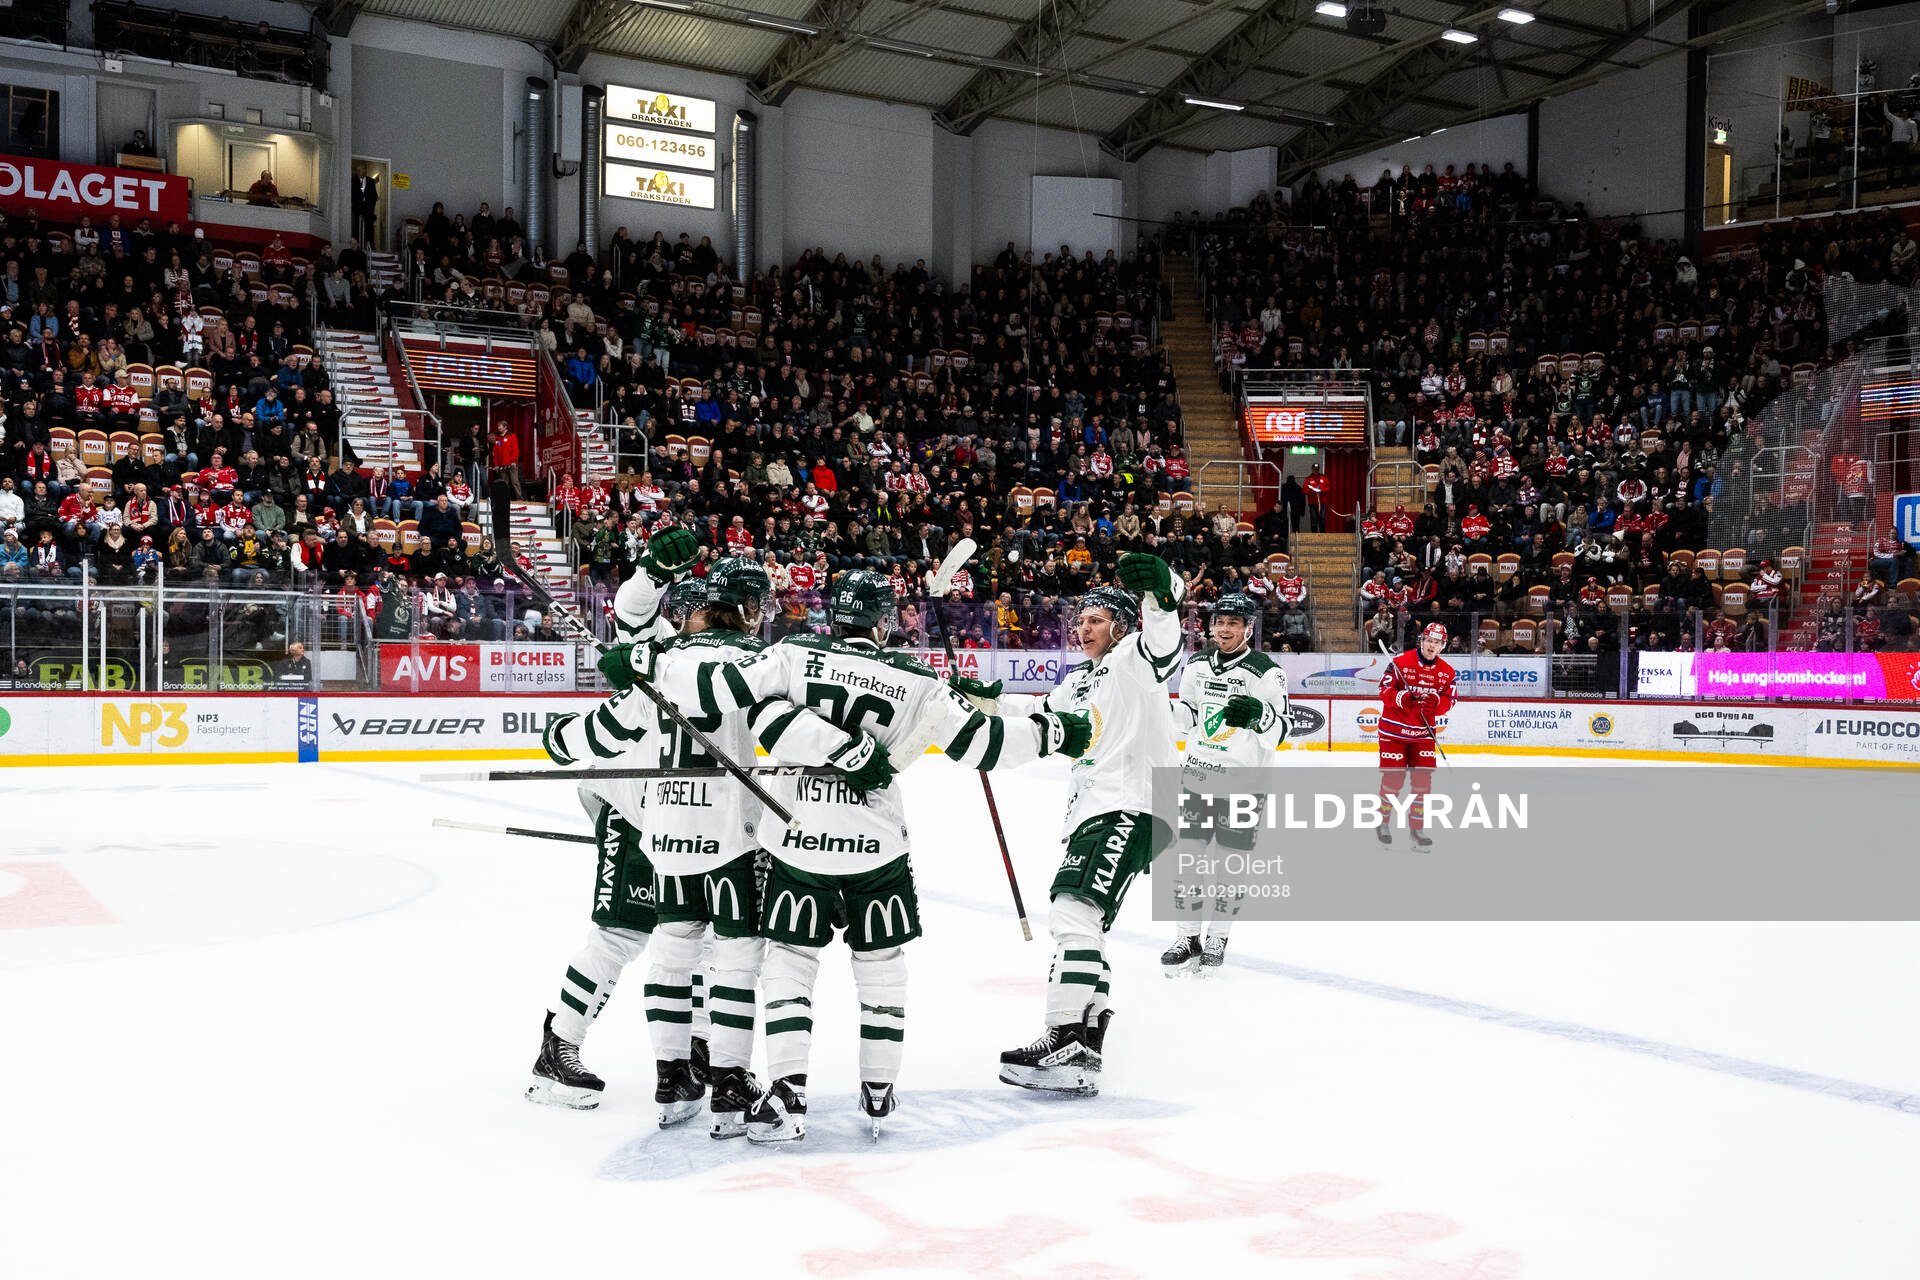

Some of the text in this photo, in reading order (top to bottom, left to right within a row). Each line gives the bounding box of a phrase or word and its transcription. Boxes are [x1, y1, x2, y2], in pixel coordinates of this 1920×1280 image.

[631, 113, 693, 128] DRAKSTADEN
[1708, 115, 1733, 133] Kiosk
[616, 133, 706, 158] 060-123456
[630, 190, 691, 205] DRAKSTADEN
[132, 374, 151, 384] MAXI
[191, 379, 209, 389] MAXI
[84, 442, 104, 452] MAXI
[90, 480, 112, 490] MAXI
[462, 533, 481, 543] MAXI
[1500, 563, 1518, 573] MAXI
[1699, 560, 1717, 570] MAXI
[1724, 559, 1743, 569] MAXI
[839, 591, 854, 604] 26
[1725, 594, 1744, 604] MAXI
[1514, 630, 1532, 640] MAXI
[490, 651, 566, 666] BUCHER
[393, 655, 467, 681] AVIS
[536, 671, 566, 685] glass
[1452, 668, 1538, 683] eamsters
[1708, 670, 1740, 685] Heja
[829, 668, 908, 702] Infrakraft
[197, 713, 219, 723] NP3
[1487, 708, 1572, 720] TILLSAMMANS ÄR
[1716, 712, 1740, 720] Bygg
[1741, 712, 1755, 721] AB
[101, 702, 190, 748] NP3
[197, 723, 252, 736] Fastigheter
[359, 718, 486, 736] BAUER
[1487, 719, 1559, 730] DET OMÖJLIGA
[1487, 730, 1523, 739] ENKELT
[1856, 741, 1878, 750] PART
[1380, 751, 1404, 761] coop
[781, 828, 881, 855] Helmia
